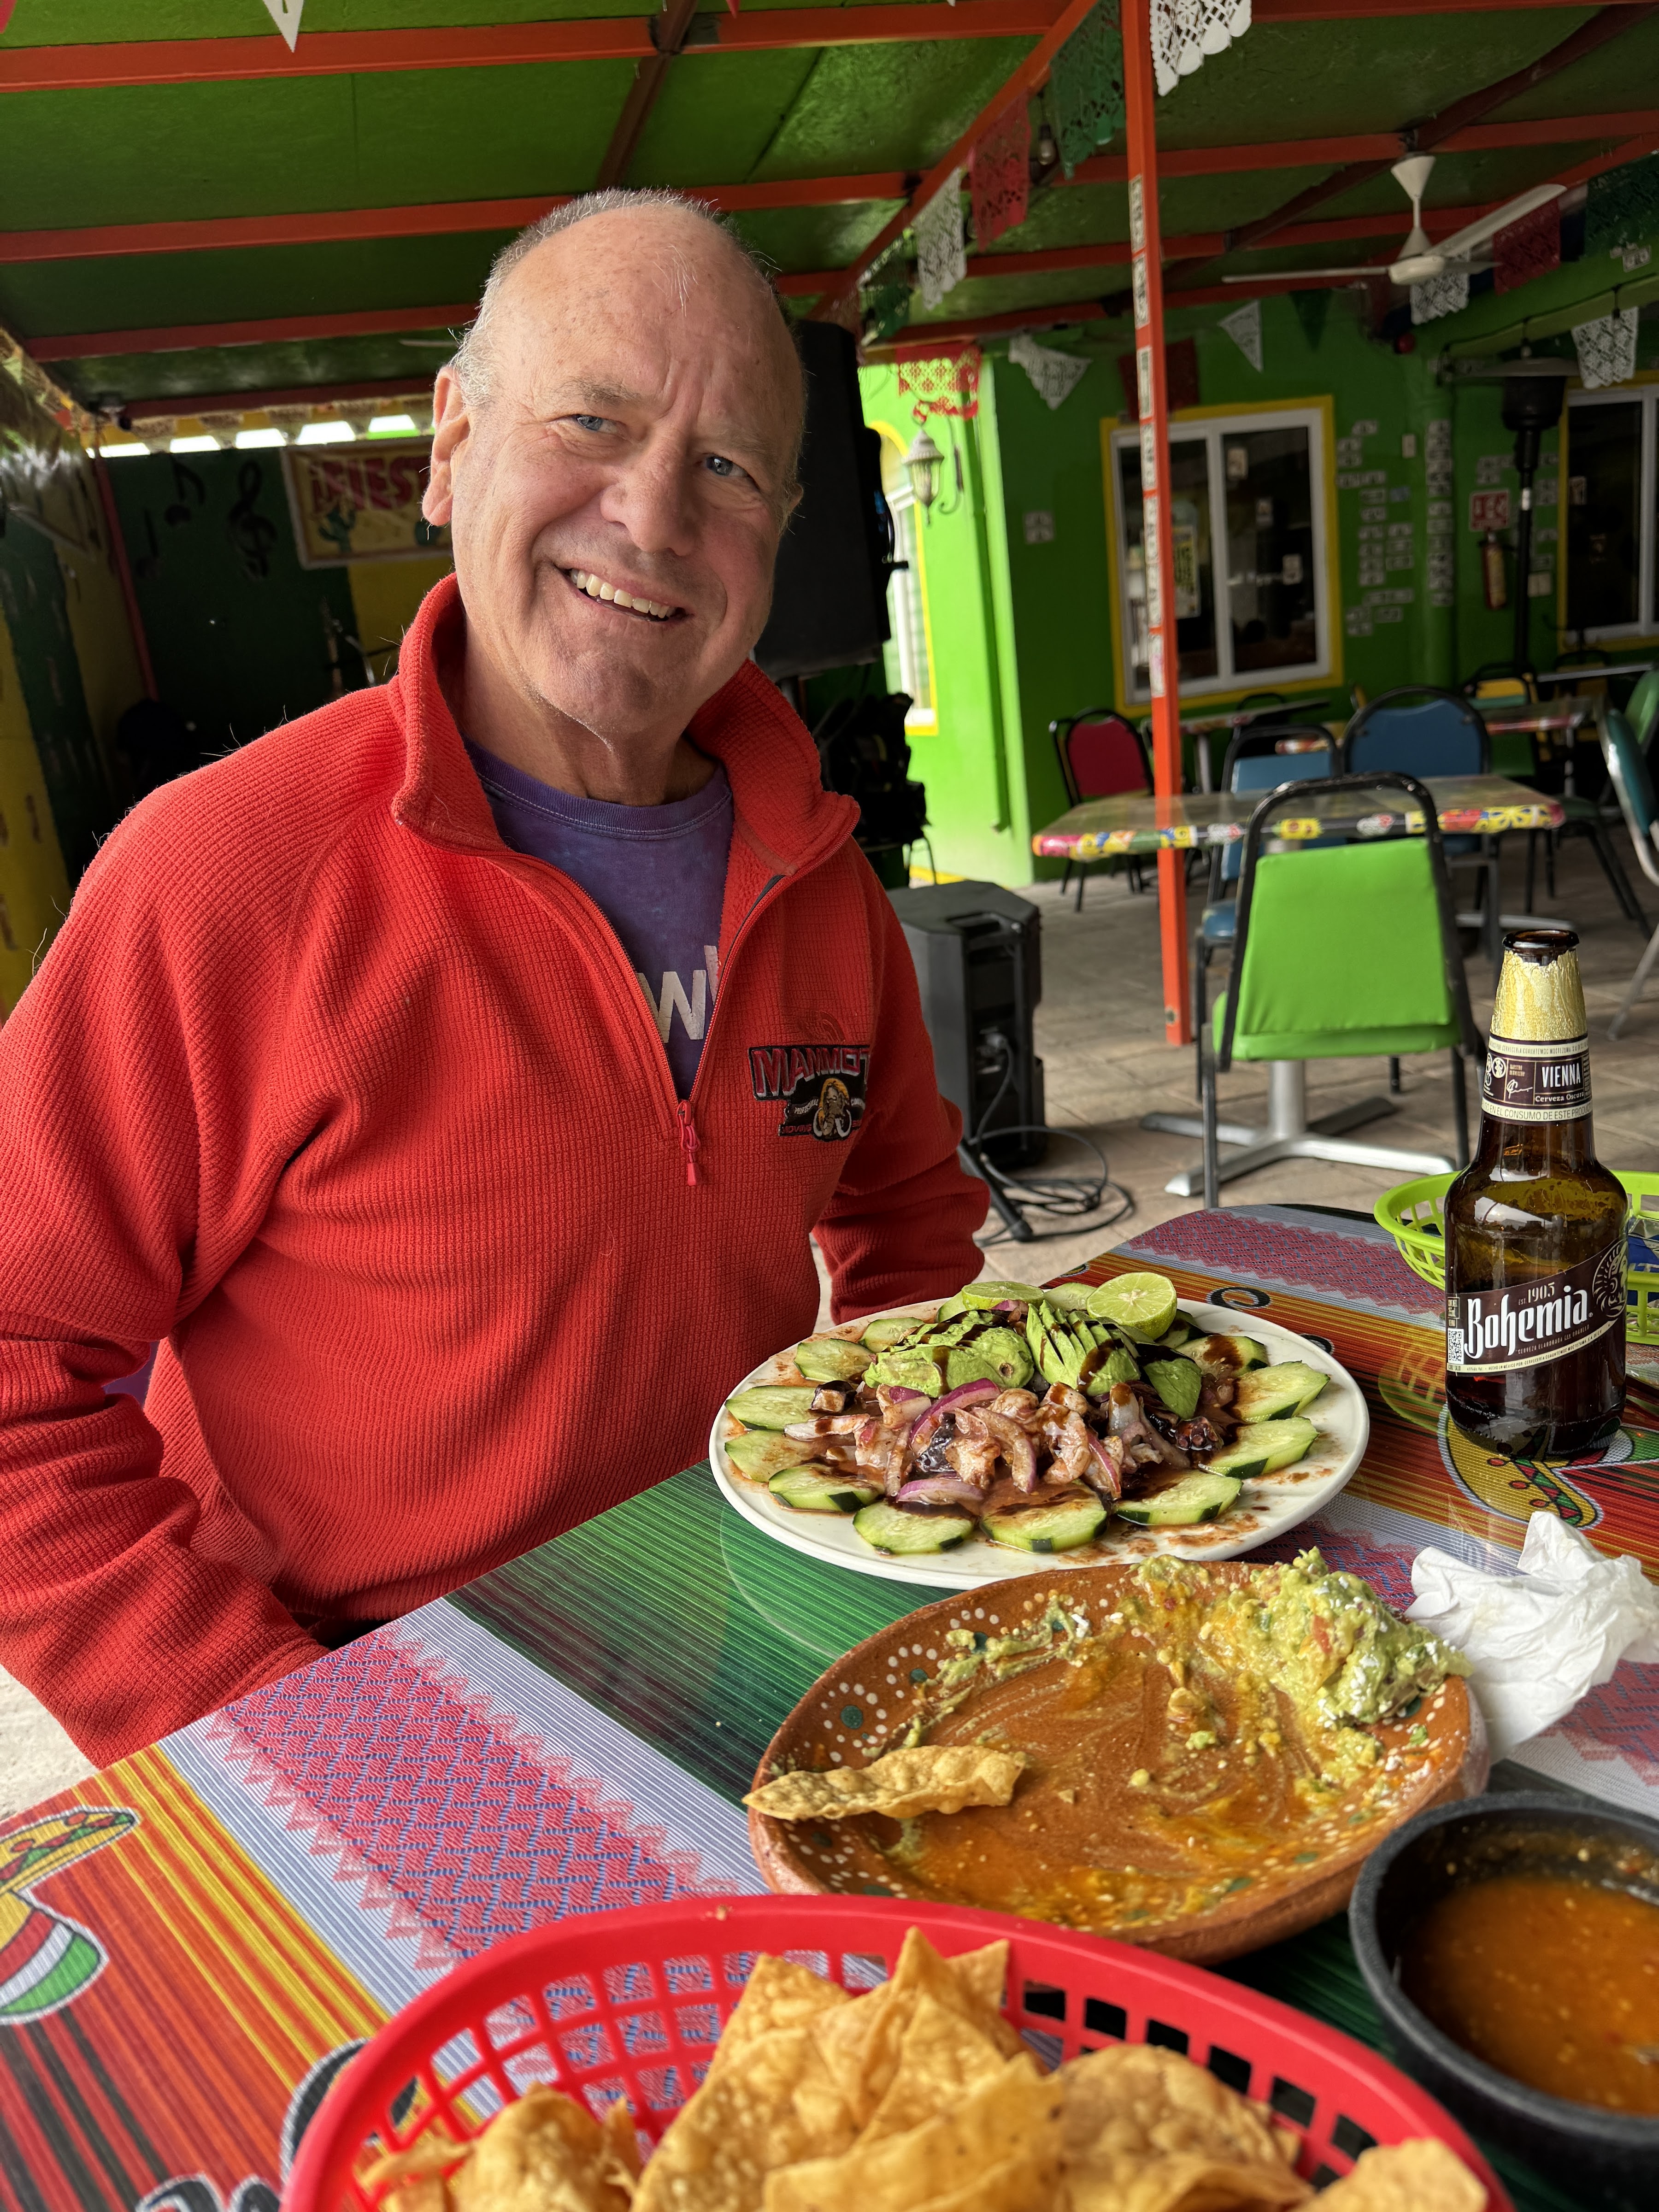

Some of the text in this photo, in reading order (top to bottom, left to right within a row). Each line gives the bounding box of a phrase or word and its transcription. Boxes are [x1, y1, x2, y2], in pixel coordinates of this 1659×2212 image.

[1542, 1063, 1581, 1088] VIENNA
[1566, 1092, 1583, 1100] Oscura
[1490, 1105, 1496, 1114] EN
[1497, 1107, 1503, 1116] EL
[1505, 1109, 1541, 1120] CONSUMO
[1543, 1112, 1553, 1120] DE
[1554, 1110, 1571, 1119] ESTE
[1464, 1285, 1587, 1359] Bohemia
[1518, 1344, 1537, 1354] CERVEZA
[1538, 1337, 1563, 1349] ELABORADA
[1572, 1324, 1589, 1337] ORGULLO
